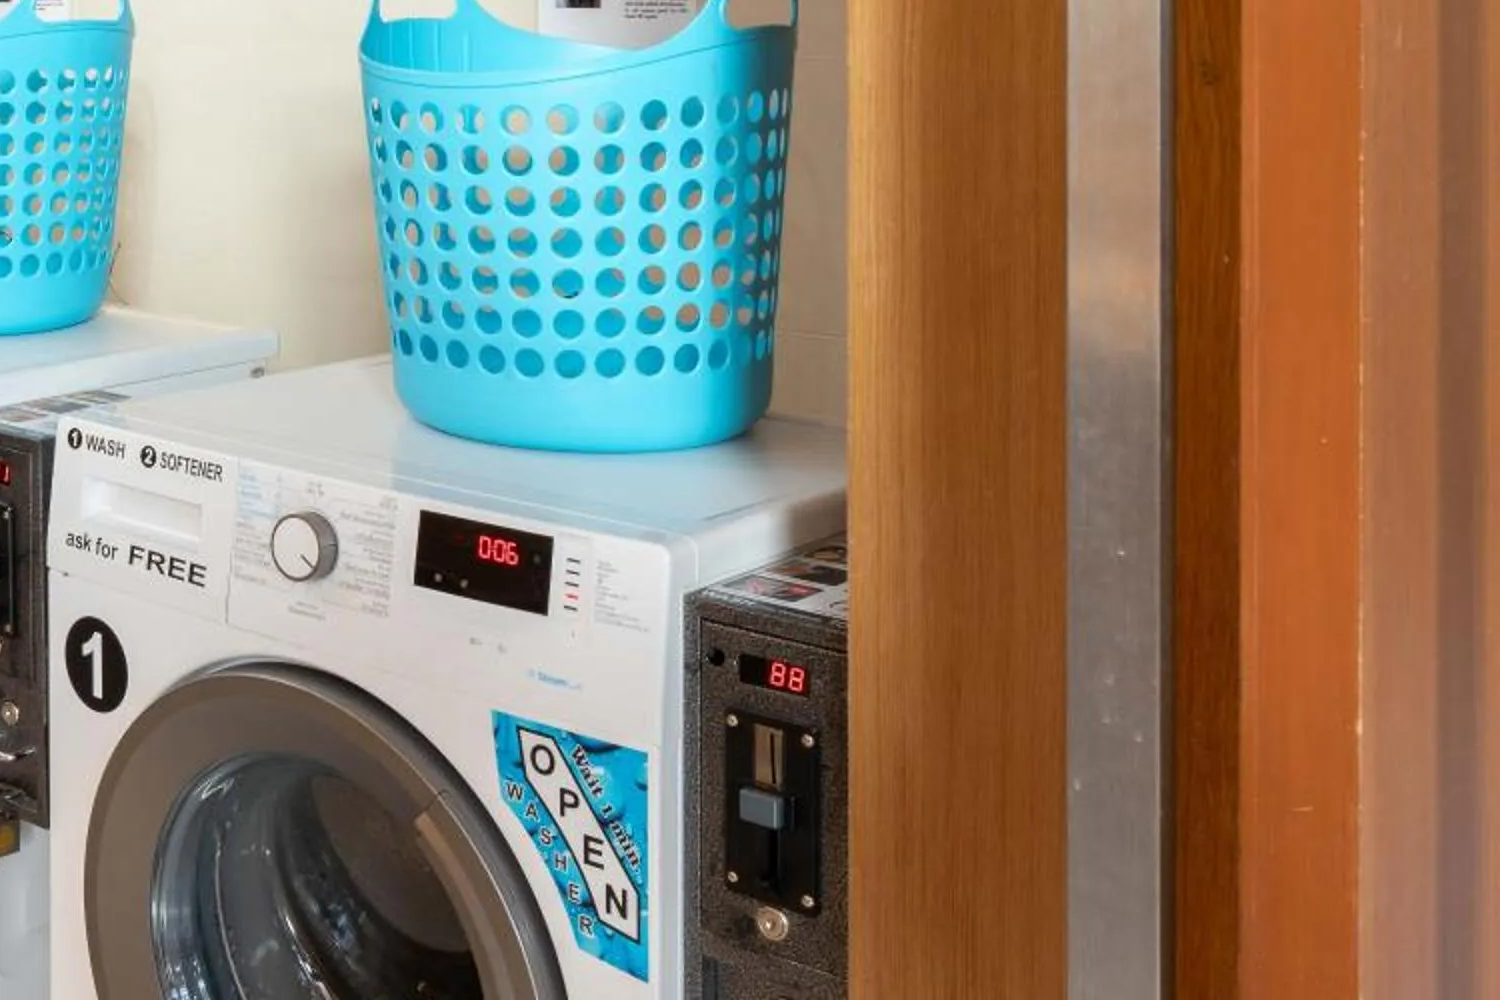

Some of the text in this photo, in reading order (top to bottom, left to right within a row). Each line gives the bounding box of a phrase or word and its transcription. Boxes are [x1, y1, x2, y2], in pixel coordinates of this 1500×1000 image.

[86, 433, 126, 459] WASH
[160, 452, 223, 482] SOFTENER
[65, 533, 207, 588] ask for FREE
[81, 631, 103, 699] 1
[769, 662, 804, 692] 88
[505, 783, 593, 935] WASHER
[530, 744, 628, 920] OPEN
